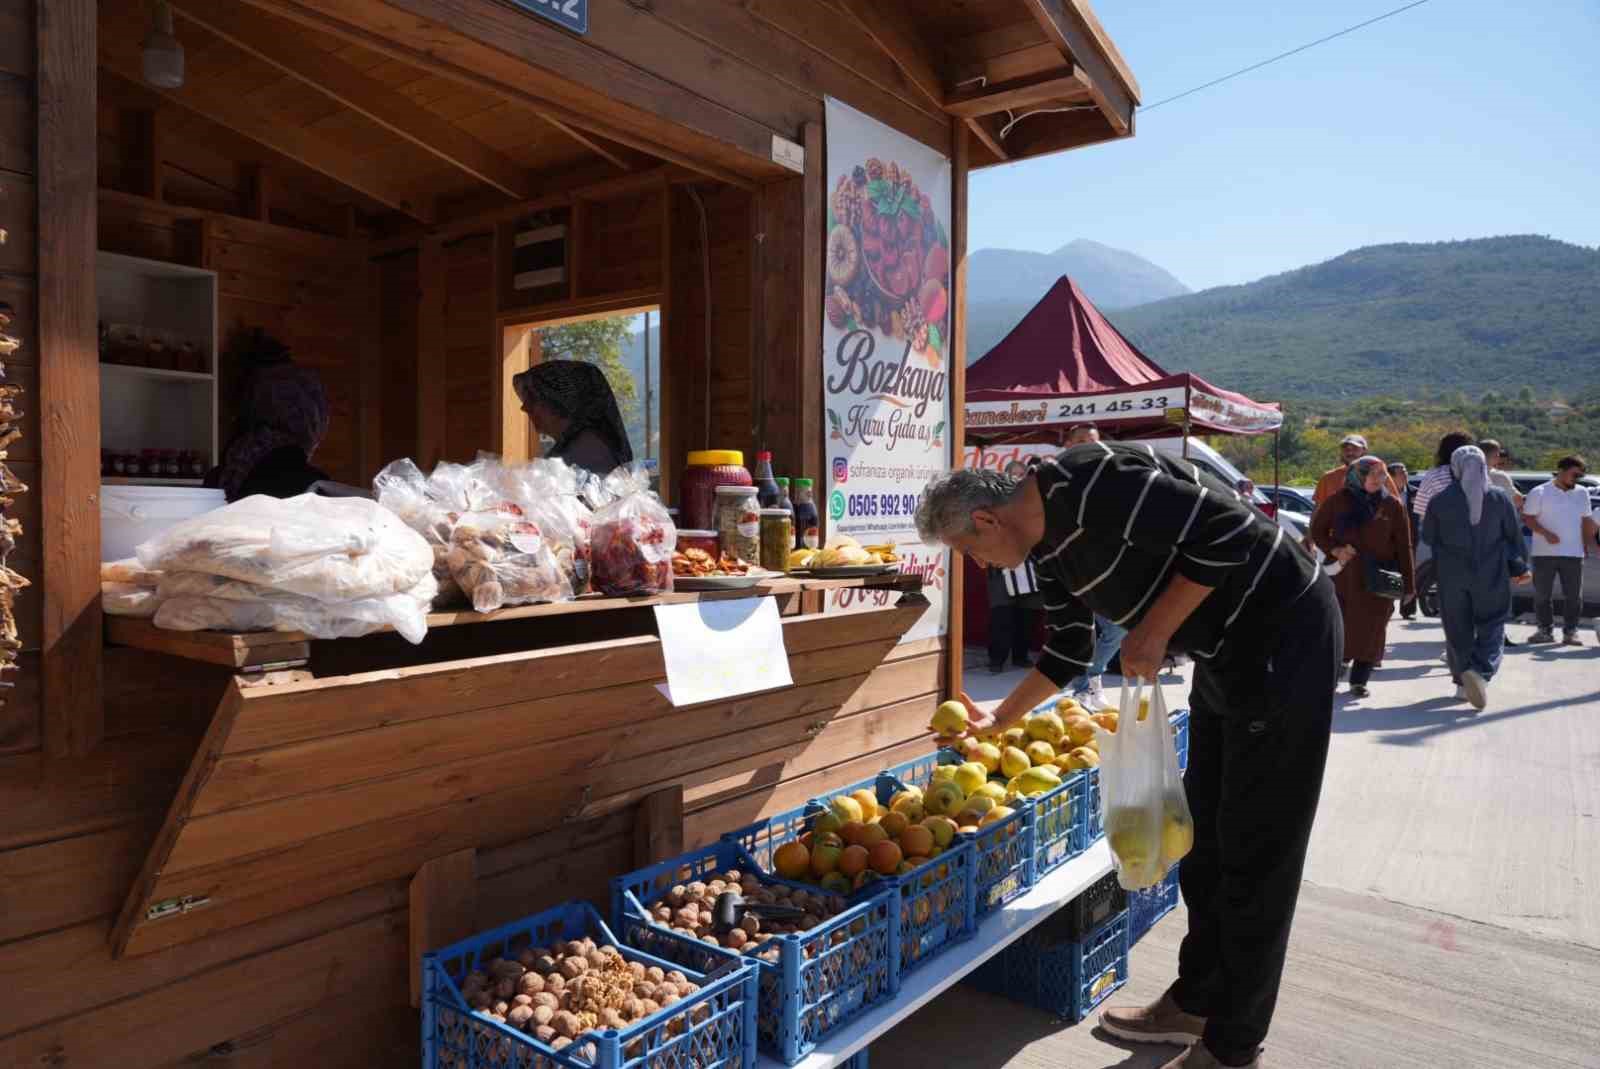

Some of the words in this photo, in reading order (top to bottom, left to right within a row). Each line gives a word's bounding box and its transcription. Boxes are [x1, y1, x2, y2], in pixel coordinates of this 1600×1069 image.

[827, 329, 945, 418] Bozkaya
[1059, 403, 1096, 417] 241
[1105, 400, 1132, 412] 45
[1141, 396, 1168, 410] 33
[845, 404, 884, 446] Kuru
[848, 494, 878, 517] 0505
[880, 494, 900, 516] 992
[902, 494, 915, 515] 90
